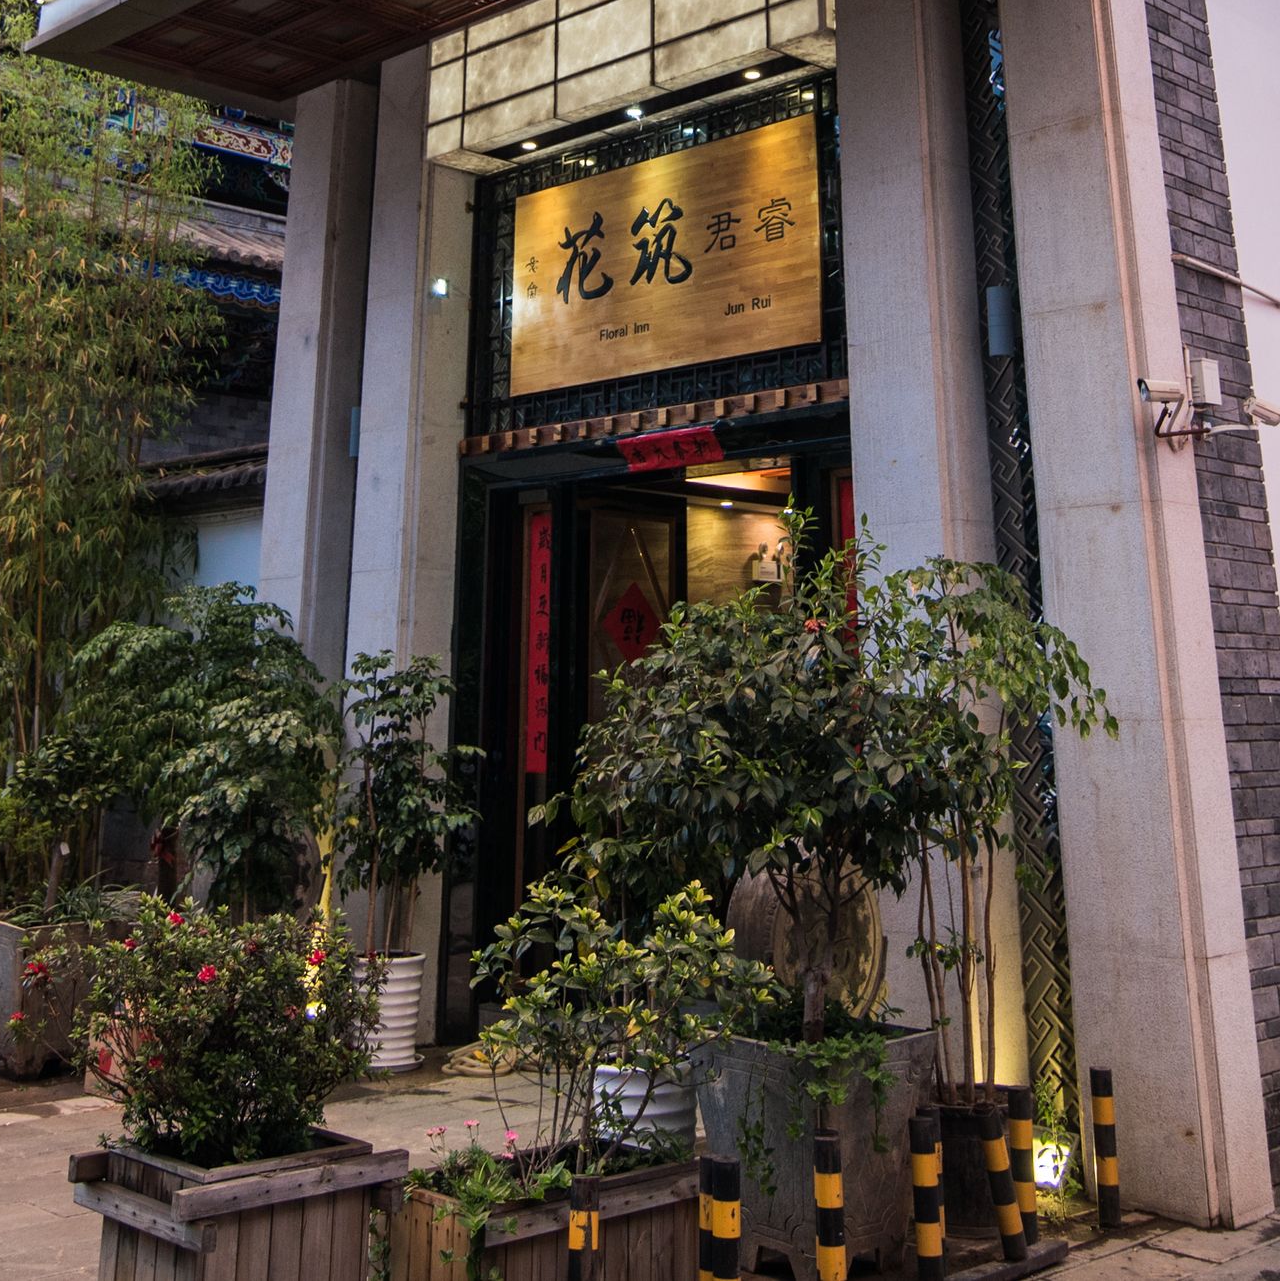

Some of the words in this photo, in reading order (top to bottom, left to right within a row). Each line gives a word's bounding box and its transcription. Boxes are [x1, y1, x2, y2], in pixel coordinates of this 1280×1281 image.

[556, 197, 693, 305] 花筑
[703, 197, 796, 254] 君睿
[724, 302, 745, 317] Jun
[751, 294, 772, 311] Rui
[599, 324, 628, 342] Floral
[633, 322, 650, 335] Inn
